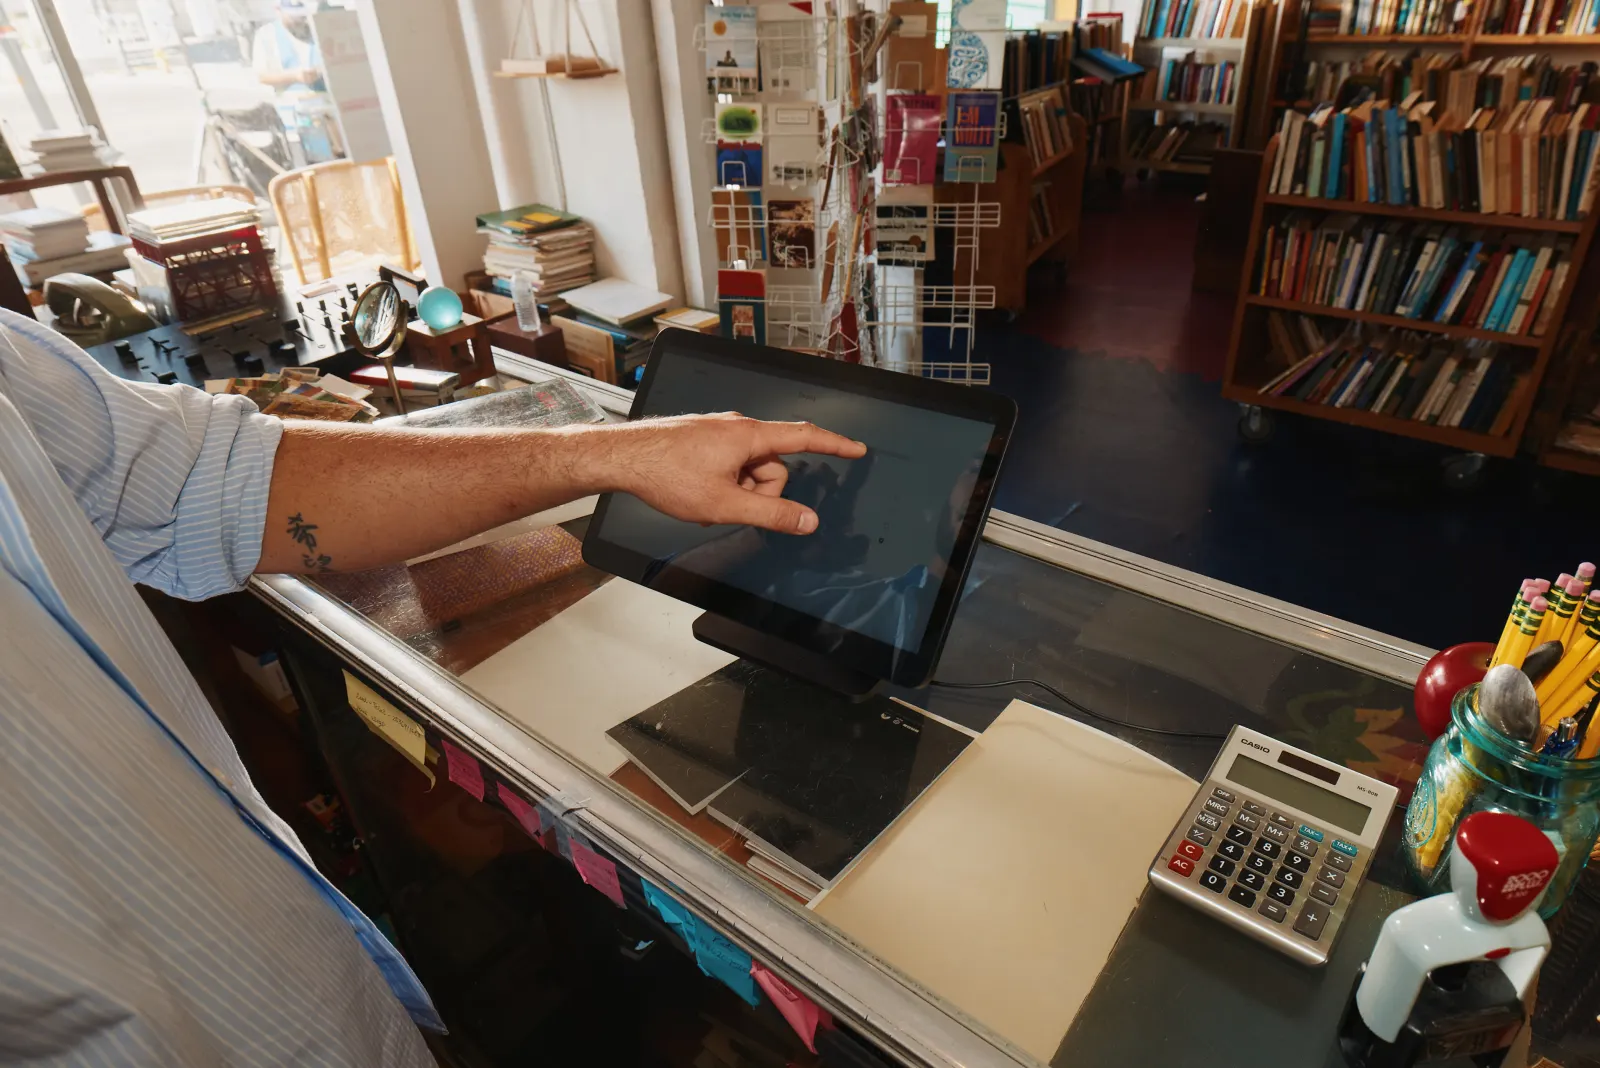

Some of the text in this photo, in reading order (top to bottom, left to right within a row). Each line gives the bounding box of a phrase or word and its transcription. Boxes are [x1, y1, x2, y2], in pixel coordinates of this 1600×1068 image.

[1240, 738, 1270, 754] CASIO
[1217, 789, 1230, 797] OFF
[1207, 800, 1226, 811] MRC
[1197, 815, 1217, 827] M/EX
[1235, 829, 1245, 837] 7
[1267, 826, 1284, 837] M+
[1185, 845, 1196, 854] C
[1225, 845, 1235, 853] 4
[1262, 842, 1272, 852] 8
[1336, 841, 1353, 851] TAX+
[1219, 860, 1225, 868] 1
[1254, 857, 1264, 867] 5
[1293, 855, 1302, 864] 9
[1173, 860, 1188, 870] AC
[1208, 875, 1218, 884] 0
[1245, 873, 1256, 883] 2
[1284, 872, 1293, 881] 6
[1276, 888, 1286, 898] 3
